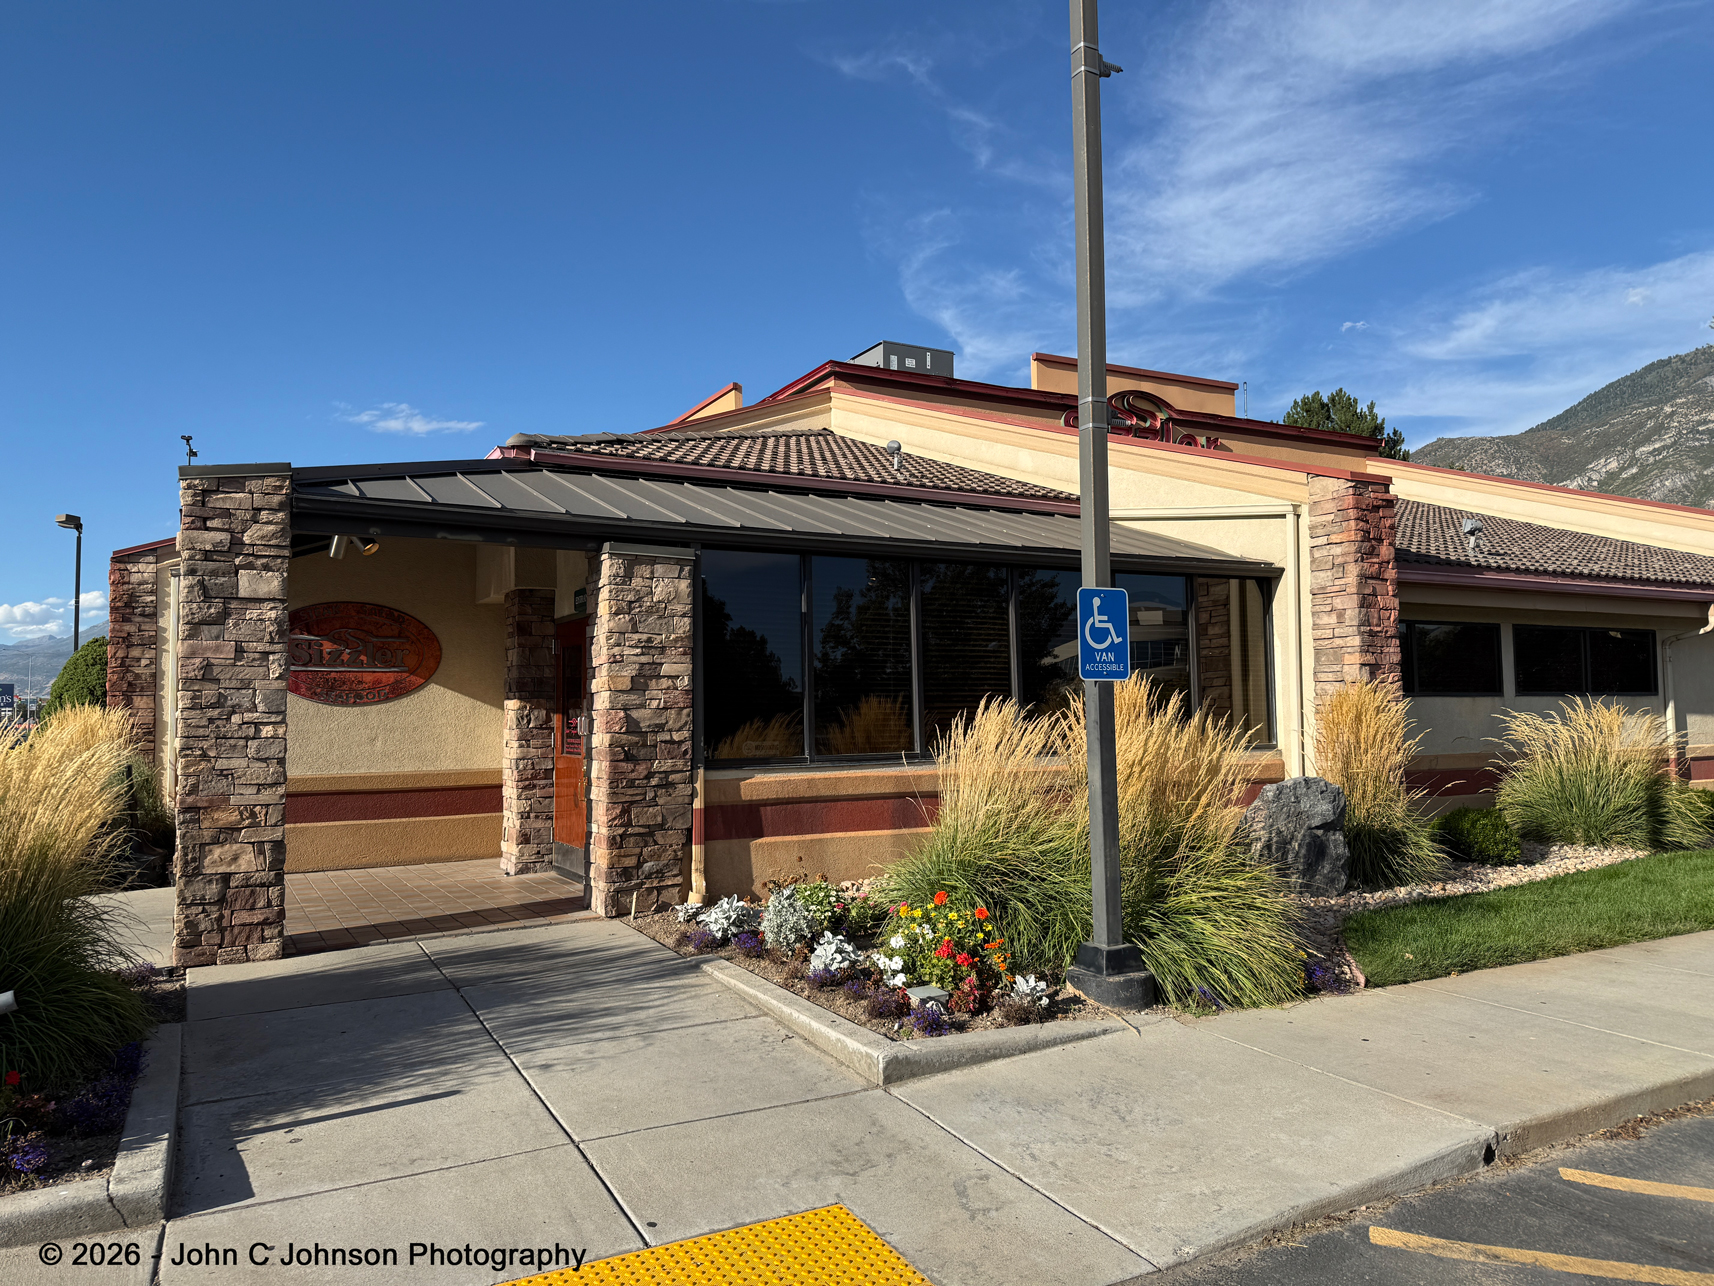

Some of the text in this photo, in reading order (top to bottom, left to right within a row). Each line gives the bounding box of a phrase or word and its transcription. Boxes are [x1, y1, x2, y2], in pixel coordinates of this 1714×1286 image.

[299, 605, 405, 623] STEAK SALAD
[289, 640, 410, 666] Sizzler
[1095, 652, 1115, 662] VAN
[318, 689, 388, 702] SEAFOOD
